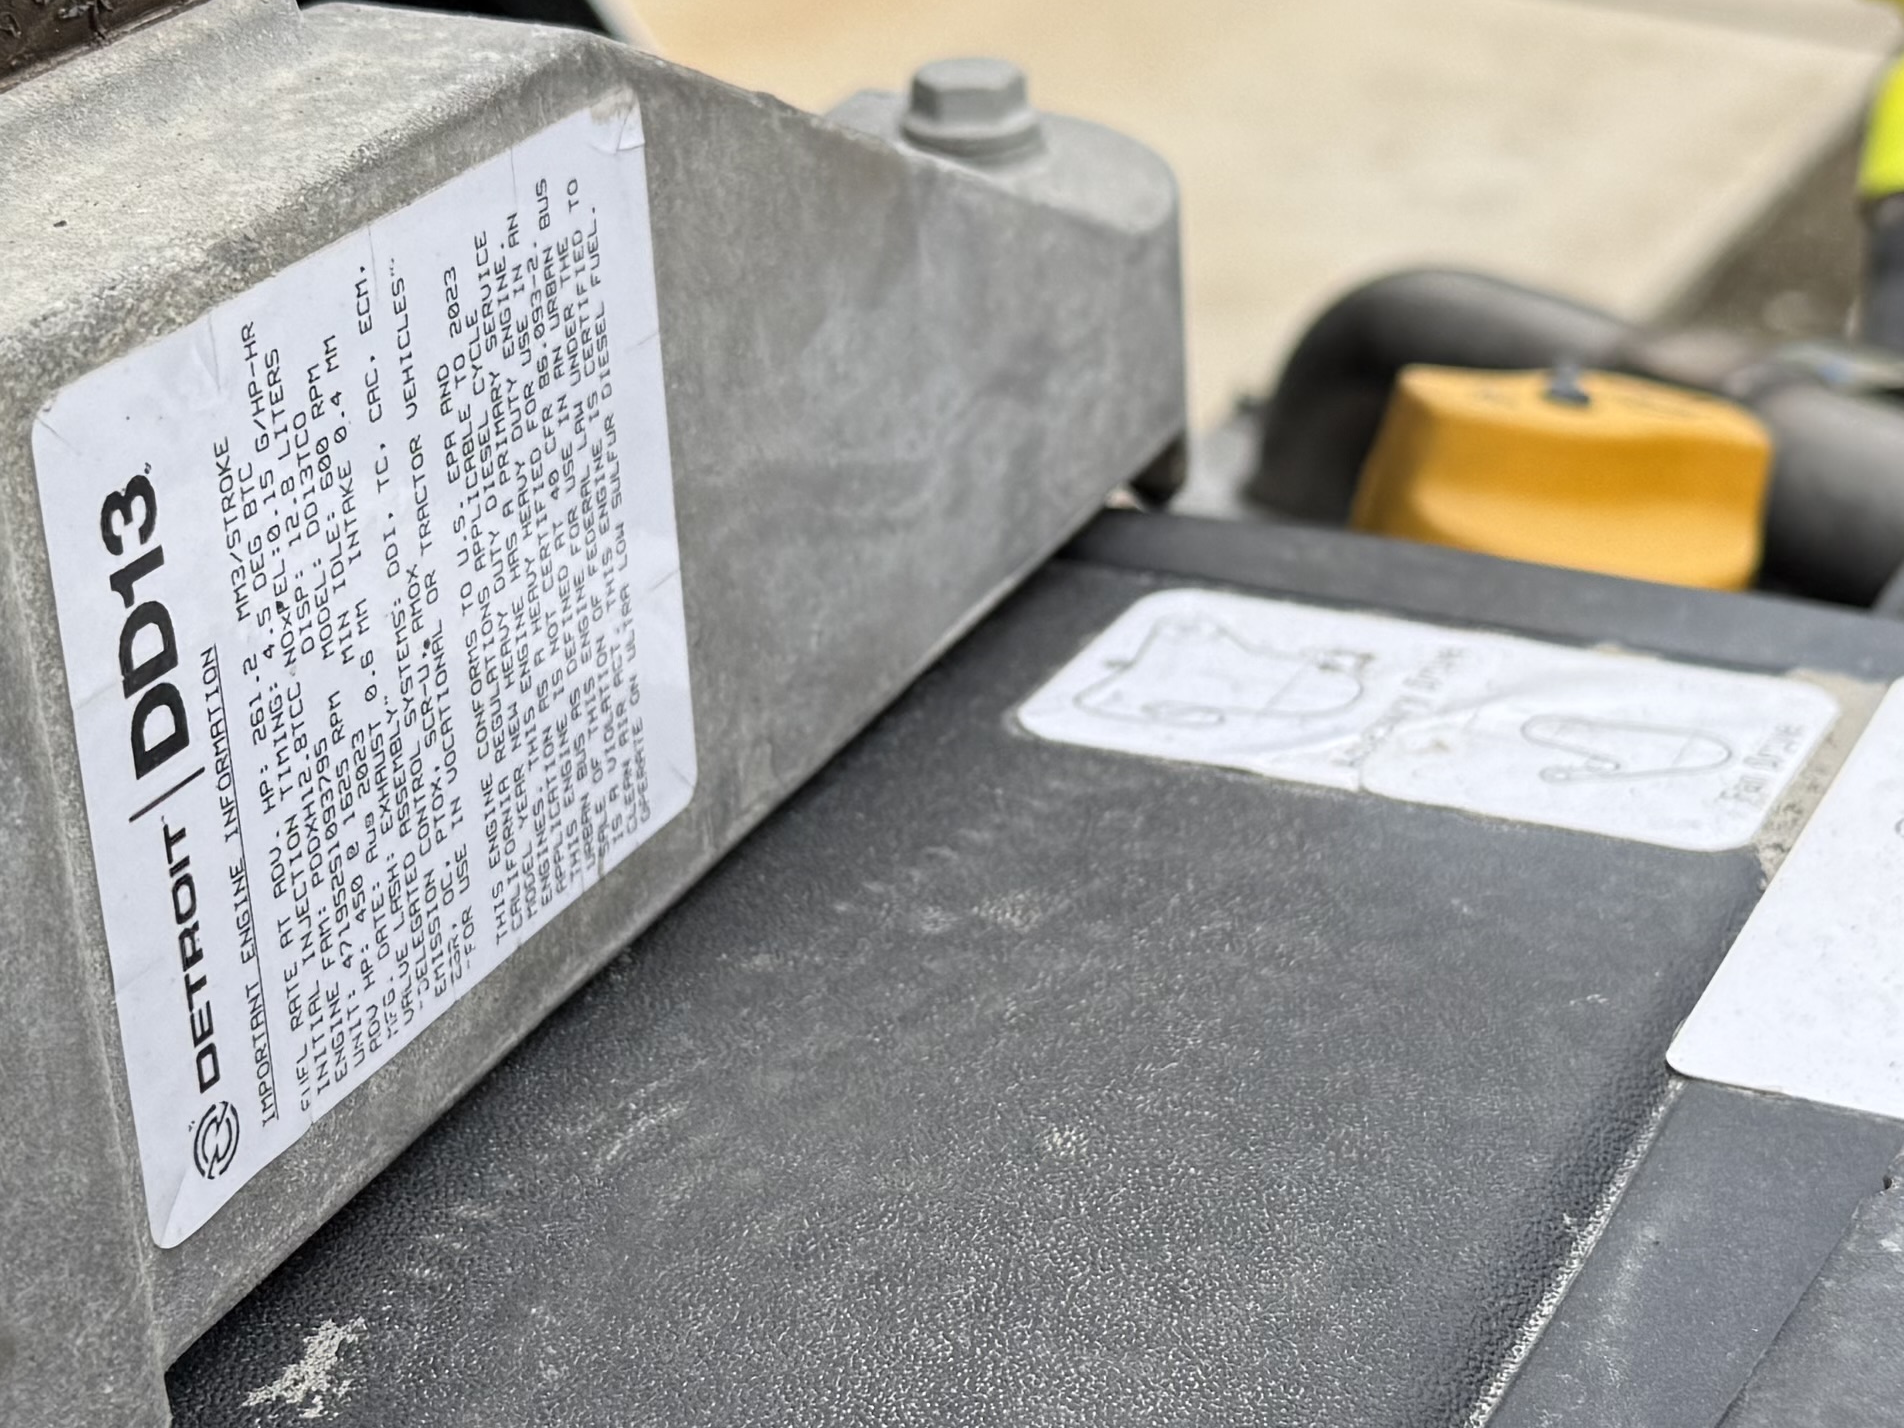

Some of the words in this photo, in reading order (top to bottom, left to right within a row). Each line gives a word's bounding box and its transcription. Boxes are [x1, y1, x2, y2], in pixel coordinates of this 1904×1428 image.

[535, 178, 550, 231] BUS
[566, 178, 579, 212] TO
[506, 211, 519, 248] AN
[556, 236, 570, 288] THE
[354, 265, 372, 335] ECM,
[443, 265, 462, 338] 2023
[473, 230, 497, 352] SERVICE
[493, 242, 514, 359] ENGINE.
[511, 263, 525, 297] IN
[542, 245, 560, 331] URBAN
[571, 229, 595, 377] CERTIFIED
[322, 334, 339, 373] MM
[452, 352, 466, 389] TO
[464, 308, 485, 396] CYCLE
[515, 314, 531, 366] USE
[551, 345, 565, 380] AN
[562, 302, 581, 386] UNDER
[240, 321, 269, 453] G/HP-HR
[264, 348, 291, 460] LITERS
[306, 362, 325, 420] RPM
[329, 390, 347, 444] 0.4
[364, 355, 382, 423] CAC,
[436, 363, 453, 416] AND
[505, 377, 523, 442] DUTY
[522, 380, 538, 432] FOR
[556, 393, 569, 426] IN
[443, 430, 460, 484] EPA
[488, 370, 511, 486] PRIMARY
[541, 403, 556, 455] CFR
[572, 400, 587, 451] LAW
[237, 461, 257, 520] BTC
[315, 435, 333, 491] 600
[374, 442, 389, 494] TC,
[408, 433, 432, 556] TRACTOR
[457, 403, 486, 572] APPLICABLE
[477, 409, 497, 512] DIESEL
[547, 468, 559, 500] 40
[560, 441, 575, 493] USE
[591, 438, 609, 535] ENGINE
[213, 436, 250, 622] MM3/STROKE
[280, 475, 301, 547] 12.8
[336, 459, 361, 565] INTAKE
[452, 501, 469, 567] U.S.
[514, 460, 532, 540] HEAVY
[529, 446, 554, 593] CERTIFIED
[567, 505, 581, 556] FOR
[579, 464, 597, 576] FEDERAL
[247, 534, 267, 592] DEG
[325, 511, 346, 594] IDLE:
[382, 512, 400, 578] DDI,
[487, 530, 505, 594] DUTY
[505, 531, 520, 583] HAS
[551, 521, 565, 551] AT
[293, 569, 315, 655] DISP:
[312, 557, 335, 660] MODEL:
[405, 563, 424, 633] AMOX
[423, 569, 438, 605] OR
[459, 580, 473, 616] TO
[523, 557, 541, 635] HEAVY
[601, 547, 615, 611] THIS
[99, 466, 190, 780] DD13
[255, 606, 275, 659] 4.5
[336, 609, 354, 665] MIN
[354, 597, 370, 635] MM
[496, 611, 515, 689] HEAVY
[511, 595, 532, 694] ENGINE
[544, 610, 559, 656] NOT
[557, 564, 577, 676] DEFINED
[573, 569, 592, 664] ENGINE
[359, 649, 377, 702] 0.6
[390, 597, 416, 727] SYSTEMS:
[464, 628, 489, 760] CONFORMS
[477, 585, 506, 764] REGULATIONS
[536, 678, 549, 713] AS
[551, 667, 564, 700] IS
[242, 653, 267, 745] 261.2
[327, 689, 345, 745] RPM
[428, 618, 457, 784] VOCATIONAL
[507, 701, 521, 752] NEW
[569, 686, 581, 721] AS
[583, 675, 598, 739] THIS
[199, 644, 239, 842] INFORMATION
[268, 681, 293, 801] TIMING:
[350, 728, 370, 799] 2023
[522, 705, 538, 771] THIS
[555, 713, 574, 808] ENGINE
[573, 732, 587, 781] BUS
[258, 764, 276, 814] HP:
[335, 757, 355, 825] 1625
[367, 720, 393, 835] EXHAUST
[408, 739, 431, 857] CONTROL
[429, 765, 447, 845] PTOX,
[512, 763, 528, 829] YEAR
[541, 724, 566, 894] APPLICATION
[364, 811, 378, 863] Aug
[449, 795, 463, 830] IN
[480, 772, 500, 869] ENGINE
[531, 786, 552, 906] ENGINES.
[268, 830, 287, 899] ADV.
[345, 840, 359, 861] @
[440, 860, 454, 906] OC,
[454, 842, 470, 894] USE
[497, 775, 523, 931] CALIFORNIA
[521, 841, 537, 919] MODEL
[565, 818, 581, 882] THIS
[228, 857, 255, 964] ENGINE
[283, 813, 315, 966] INJECTION
[350, 873, 366, 923] 450
[370, 881, 390, 961] DATE:
[386, 852, 404, 932] LASH:
[491, 880, 507, 945] THIS
[162, 823, 220, 1094] DETROIT
[276, 916, 293, 949] AT
[317, 905, 335, 970] FAM:
[423, 868, 446, 997] EMISSION
[283, 961, 304, 1032] RATE
[359, 943, 375, 991] HP:
[395, 942, 414, 1025] VALVE
[244, 981, 276, 1127] IMPORTANT
[307, 979, 330, 1095] INITIAL
[325, 981, 347, 1083] ENGINE
[346, 989, 365, 1068] UNIT:
[365, 1003, 382, 1053] ADV
